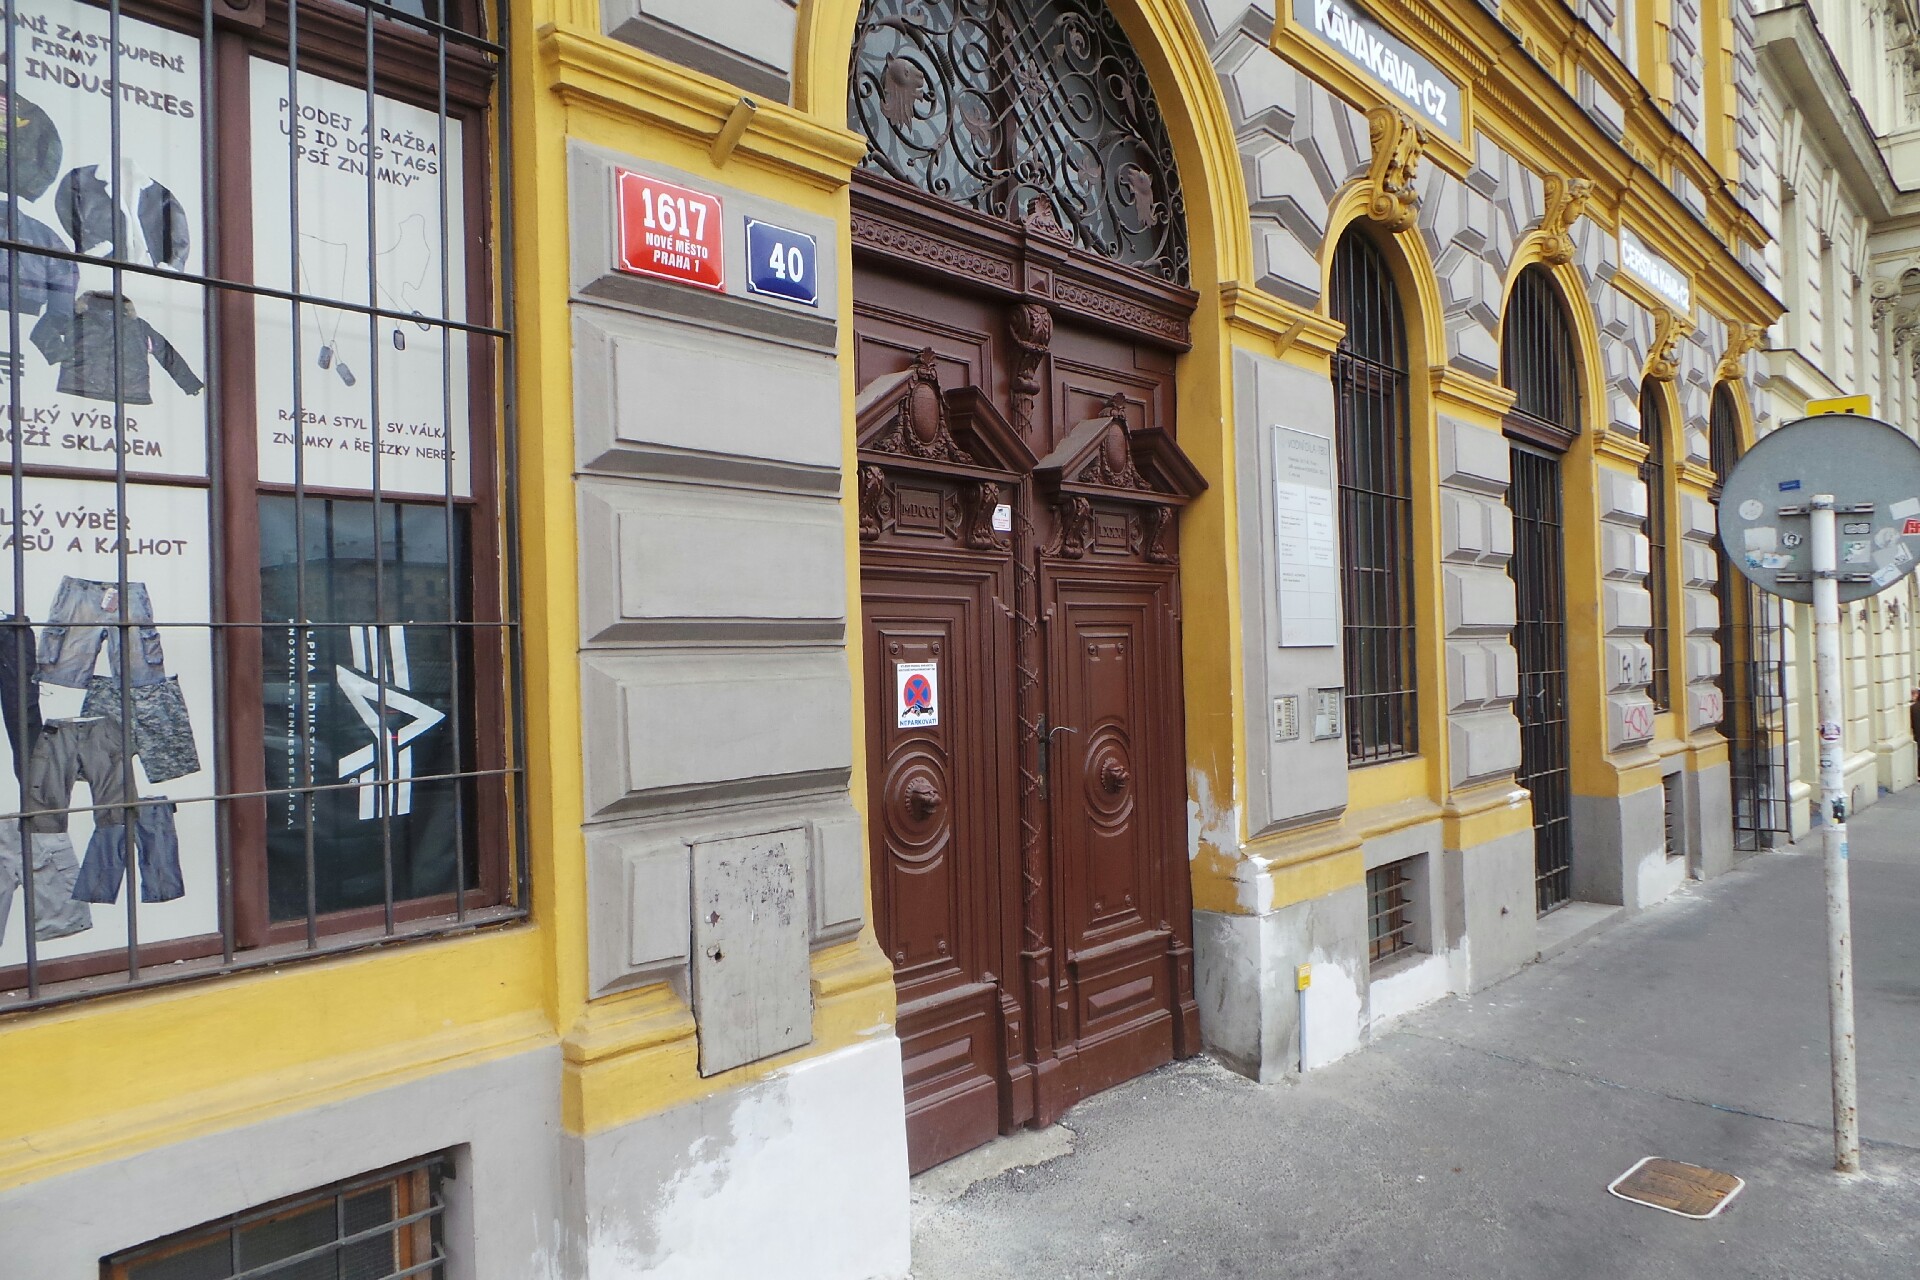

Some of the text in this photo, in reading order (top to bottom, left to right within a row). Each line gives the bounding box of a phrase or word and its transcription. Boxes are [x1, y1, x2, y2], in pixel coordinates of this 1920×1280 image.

[32, 36, 97, 67] FIRMY
[25, 57, 195, 118] INDUSTRIES
[280, 119, 438, 175] US ID DOG TAGS
[381, 127, 437, 156] RAŽBA
[290, 141, 420, 187] PSÍ ZNMKY"
[642, 187, 707, 241] 1617
[645, 232, 708, 259] NOVÉ MĚSTO
[653, 249, 700, 273] PRAHA 1
[769, 242, 804, 283] 40
[72, 408, 139, 432] VÝBR
[278, 408, 327, 426] RAŽBA
[333, 416, 368, 431] STYL
[61, 434, 163, 457] SKLADEM
[273, 432, 333, 449] ZNMKY
[340, 440, 349, 450] A
[56, 505, 131, 530] VÝBĚR
[0, 528, 187, 555] ASŮ A KALHOT
